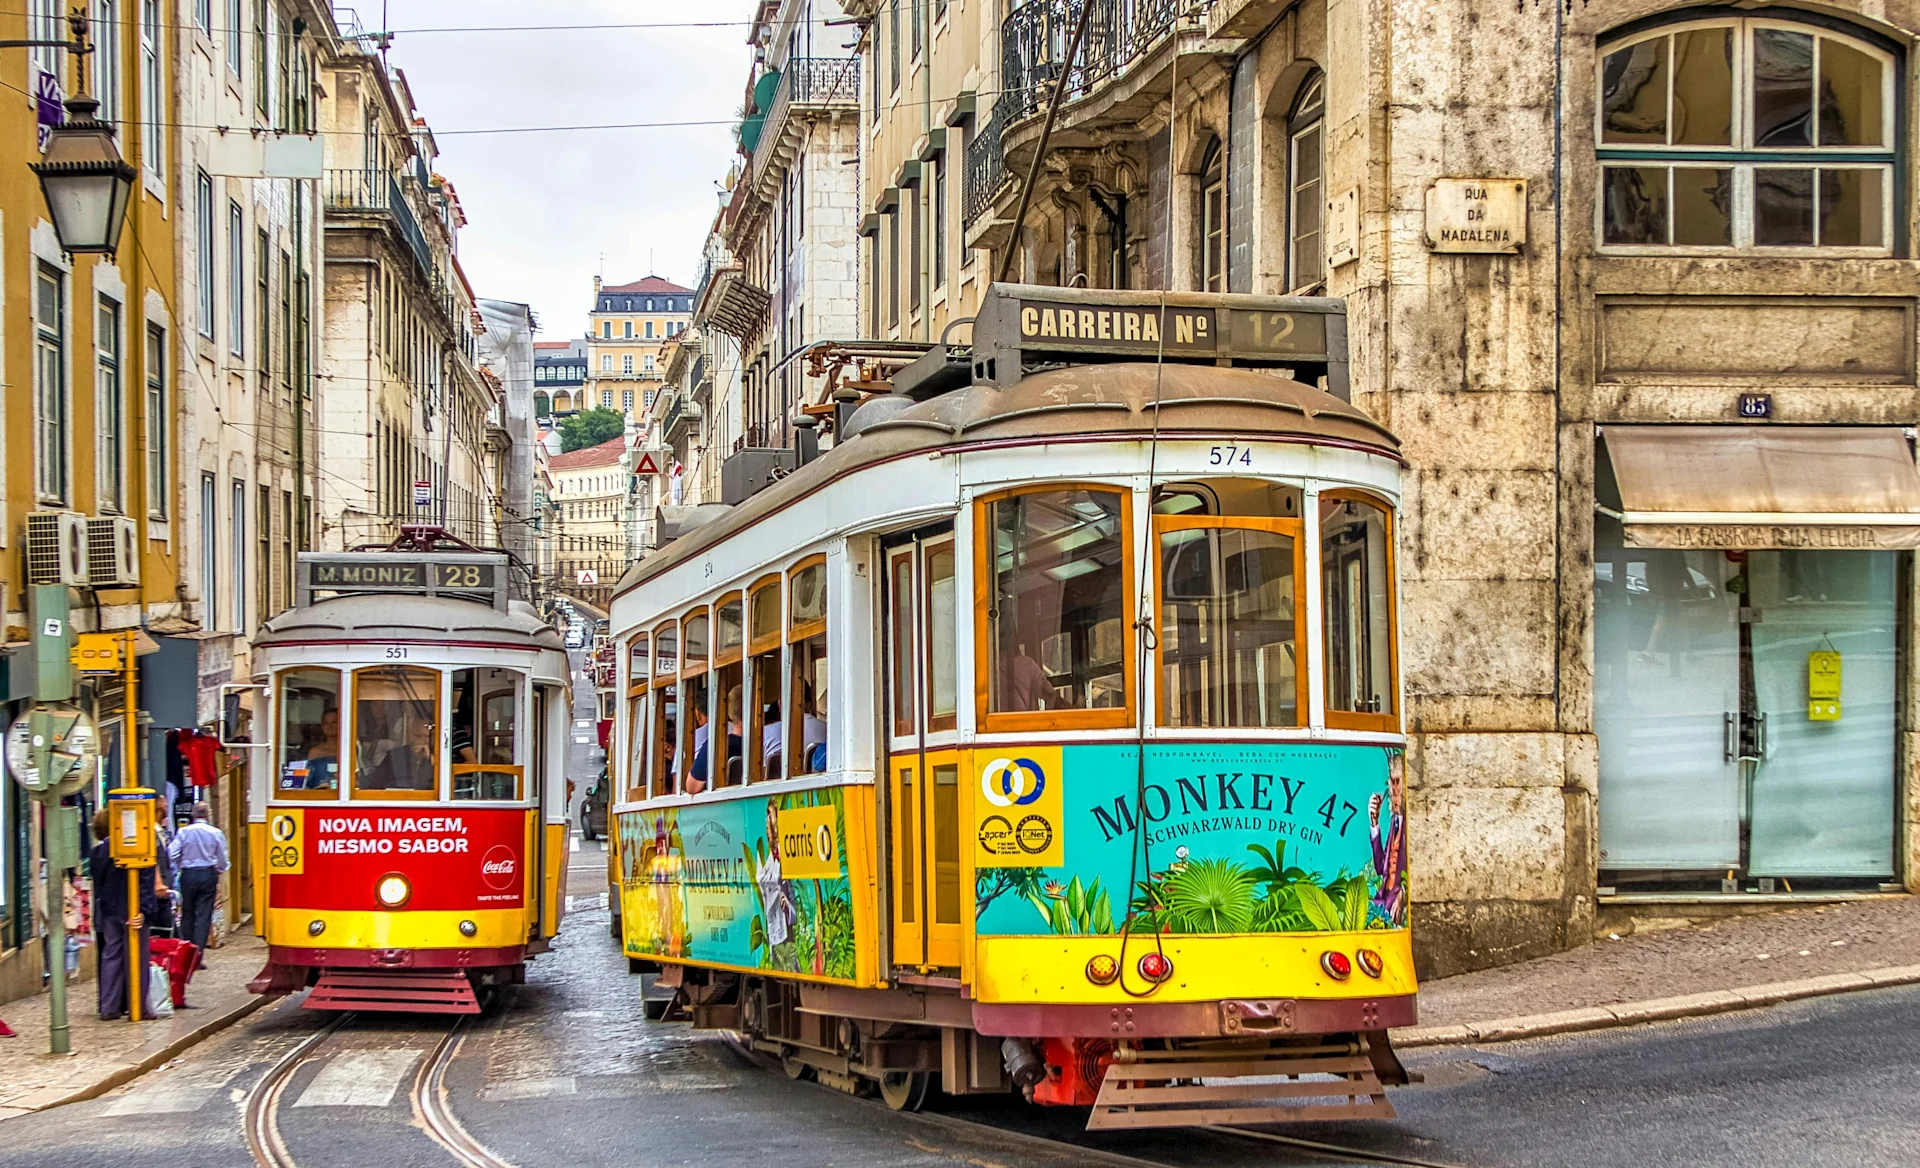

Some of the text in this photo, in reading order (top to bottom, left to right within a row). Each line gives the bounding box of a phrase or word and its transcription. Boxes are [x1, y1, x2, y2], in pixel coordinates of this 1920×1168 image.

[1465, 188, 1488, 200] RUA
[1467, 210, 1484, 221] DA
[1441, 229, 1510, 242] MADALENA
[1021, 306, 1160, 342] CARREIRA
[1248, 312, 1296, 350] 12
[1209, 446, 1252, 467] 574
[445, 565, 481, 587] 28
[385, 648, 408, 659] 551
[1089, 772, 1359, 843] MONKEY 47
[318, 817, 468, 835] NOVA IMAGEM,
[1147, 816, 1323, 847] SCHWARZWALD DRY GIN
[784, 822, 813, 859] carris
[985, 831, 1007, 841] apcer
[318, 838, 468, 854] MESMO SABOR
[686, 857, 745, 894] MONKEY 47
